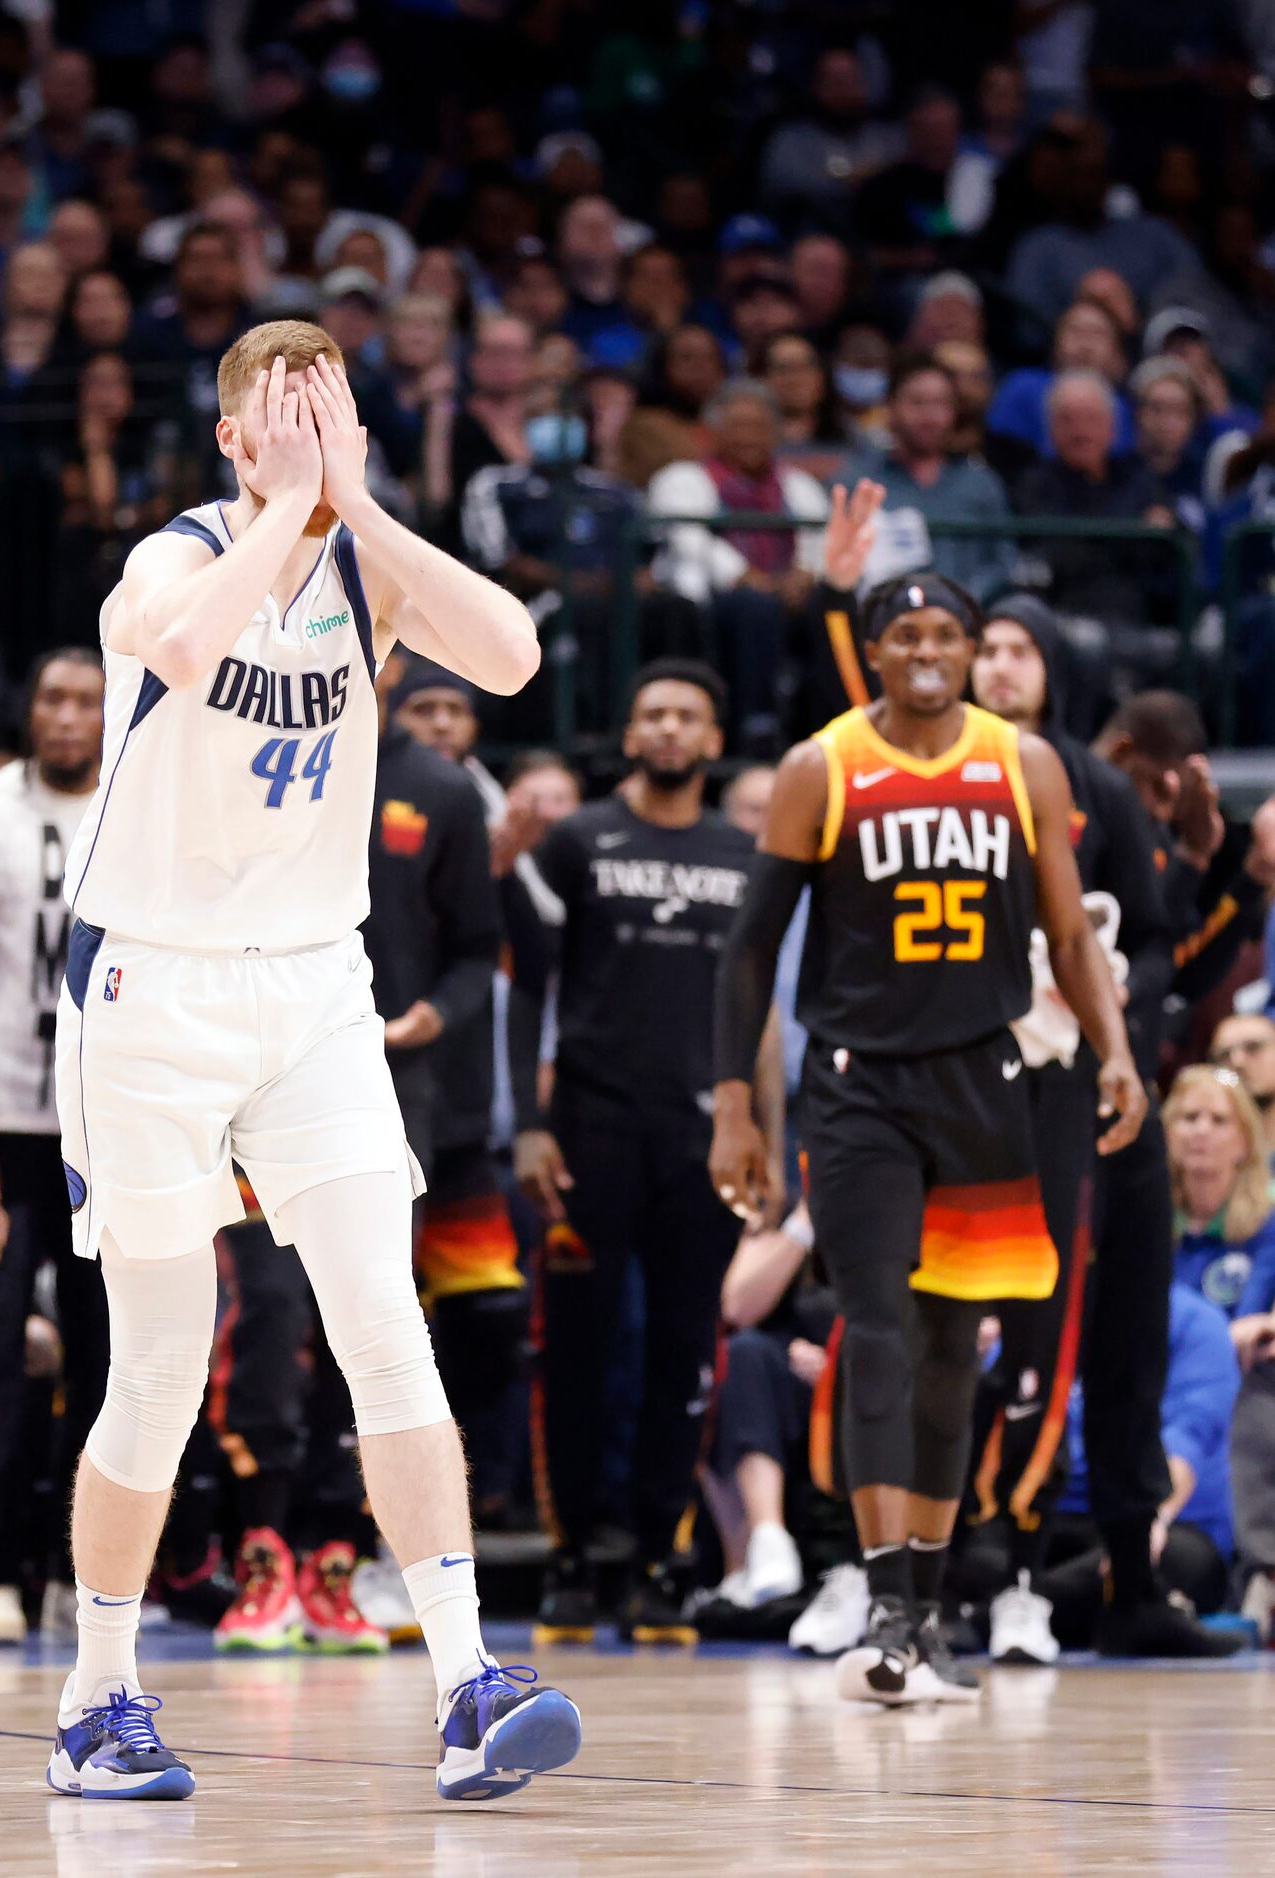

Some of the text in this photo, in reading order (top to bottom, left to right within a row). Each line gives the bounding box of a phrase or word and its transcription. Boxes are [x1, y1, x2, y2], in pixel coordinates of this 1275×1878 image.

[305, 610, 350, 639] chime
[205, 656, 352, 732] DALLAS
[250, 726, 341, 810] 44
[857, 806, 1011, 883] UTAH
[892, 879, 988, 963] 25
